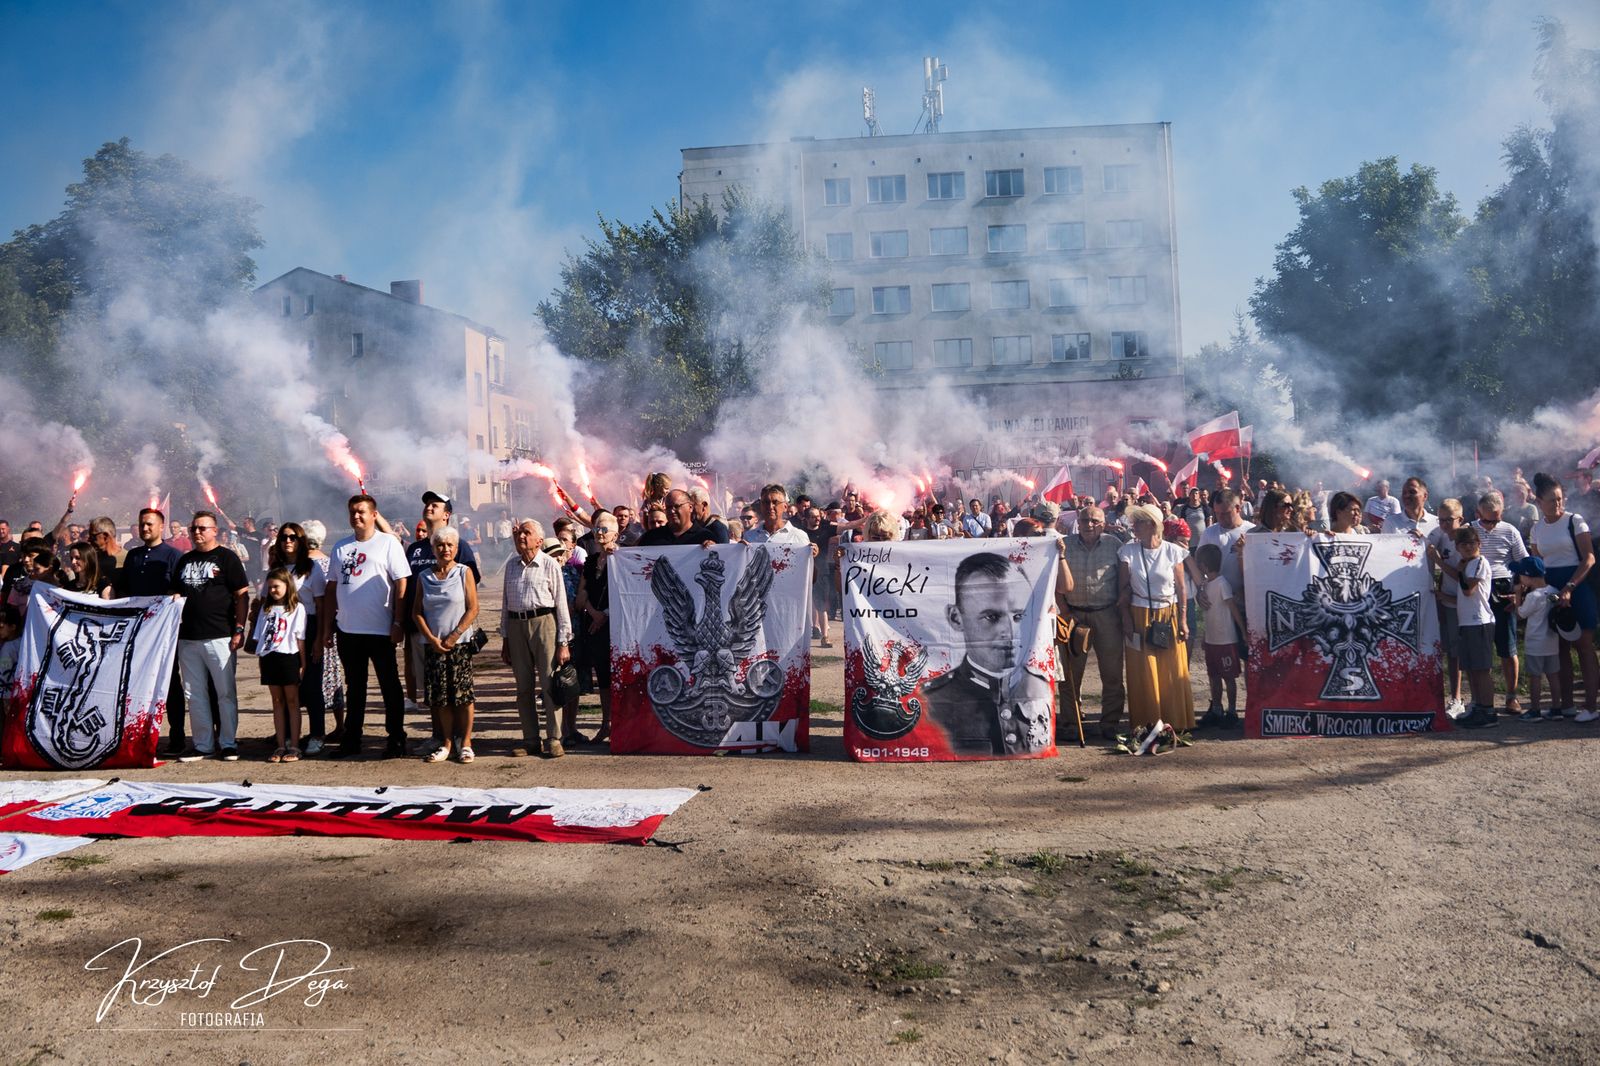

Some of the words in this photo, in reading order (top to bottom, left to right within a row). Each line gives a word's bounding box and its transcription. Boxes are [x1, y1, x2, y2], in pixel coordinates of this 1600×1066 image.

[846, 547, 892, 563] Witold
[845, 563, 930, 597] Pilecki
[849, 608, 918, 618] WITOLD
[1276, 611, 1295, 631] N
[1398, 610, 1415, 634] Z
[1265, 711, 1311, 734] ŚMIERĆ
[1316, 714, 1372, 735] WROGOM
[855, 747, 929, 757] 1901-1948
